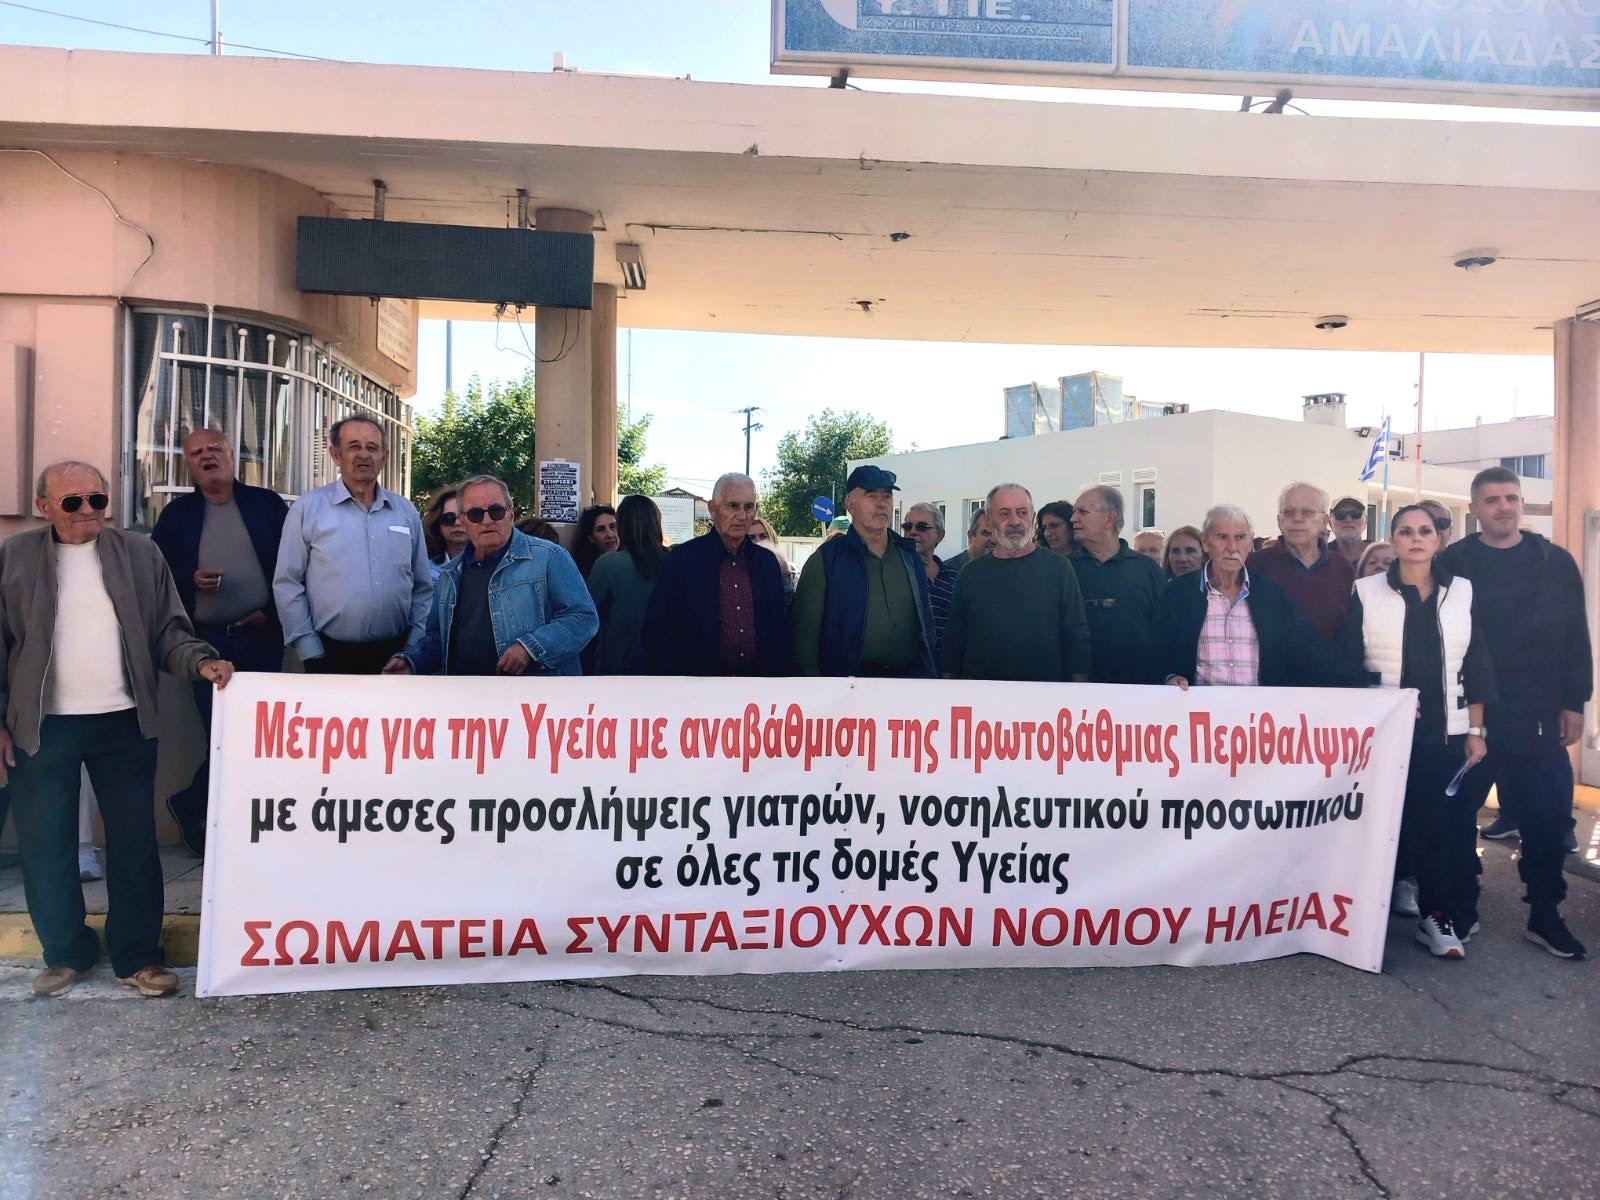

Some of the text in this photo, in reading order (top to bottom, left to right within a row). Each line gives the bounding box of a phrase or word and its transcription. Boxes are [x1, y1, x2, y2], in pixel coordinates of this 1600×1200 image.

[1288, 18, 1600, 69] ΑΜΑΛΙΑΔΑΣ
[254, 701, 1375, 778] Μέτρα για την Υγεία με αναβάθμιση της Πρωτοβάθμιας Περίθαλψης
[250, 781, 1364, 845] με άμεσες προσλήψεις γιατρών, νοσηλευτικού προσωπικού
[615, 837, 1071, 897] σε όλες τις δομές Υγείας
[240, 891, 1354, 967] ΣΩΜΑΤΕΙΑ ΣΥΝΤΑΞΙΟΥΧΩΝ ΝΟΜΟΥ ΗΛΕΙΑΣ
